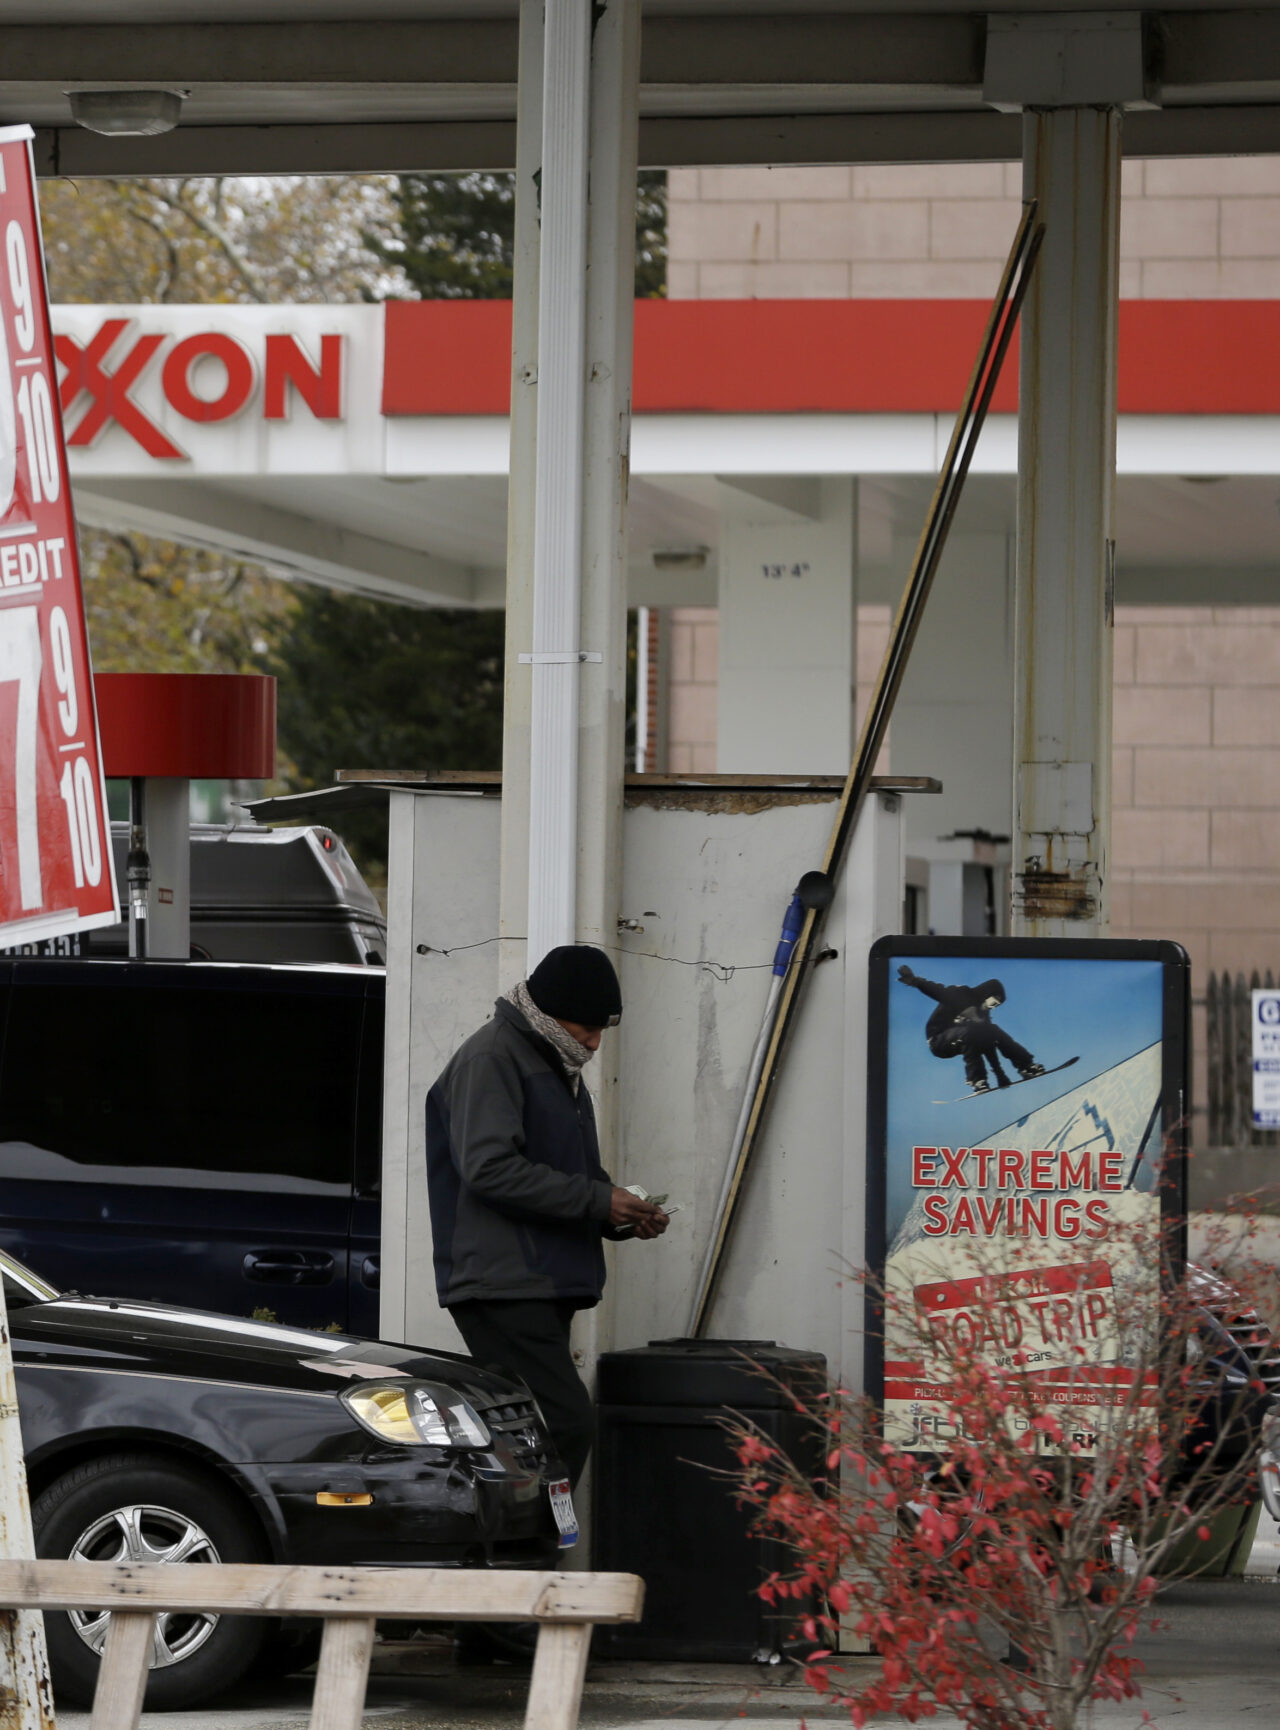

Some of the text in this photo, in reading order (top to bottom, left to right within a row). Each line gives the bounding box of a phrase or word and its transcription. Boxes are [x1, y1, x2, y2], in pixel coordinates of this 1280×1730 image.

[54, 319, 343, 459] XXON
[911, 1146, 1124, 1191] EXTREME
[922, 1194, 1111, 1240] SAVINGS
[928, 1293, 1108, 1358] ROAD TRIP
[995, 1350, 1052, 1367] we cars
[1044, 1432, 1099, 1448] PRK
